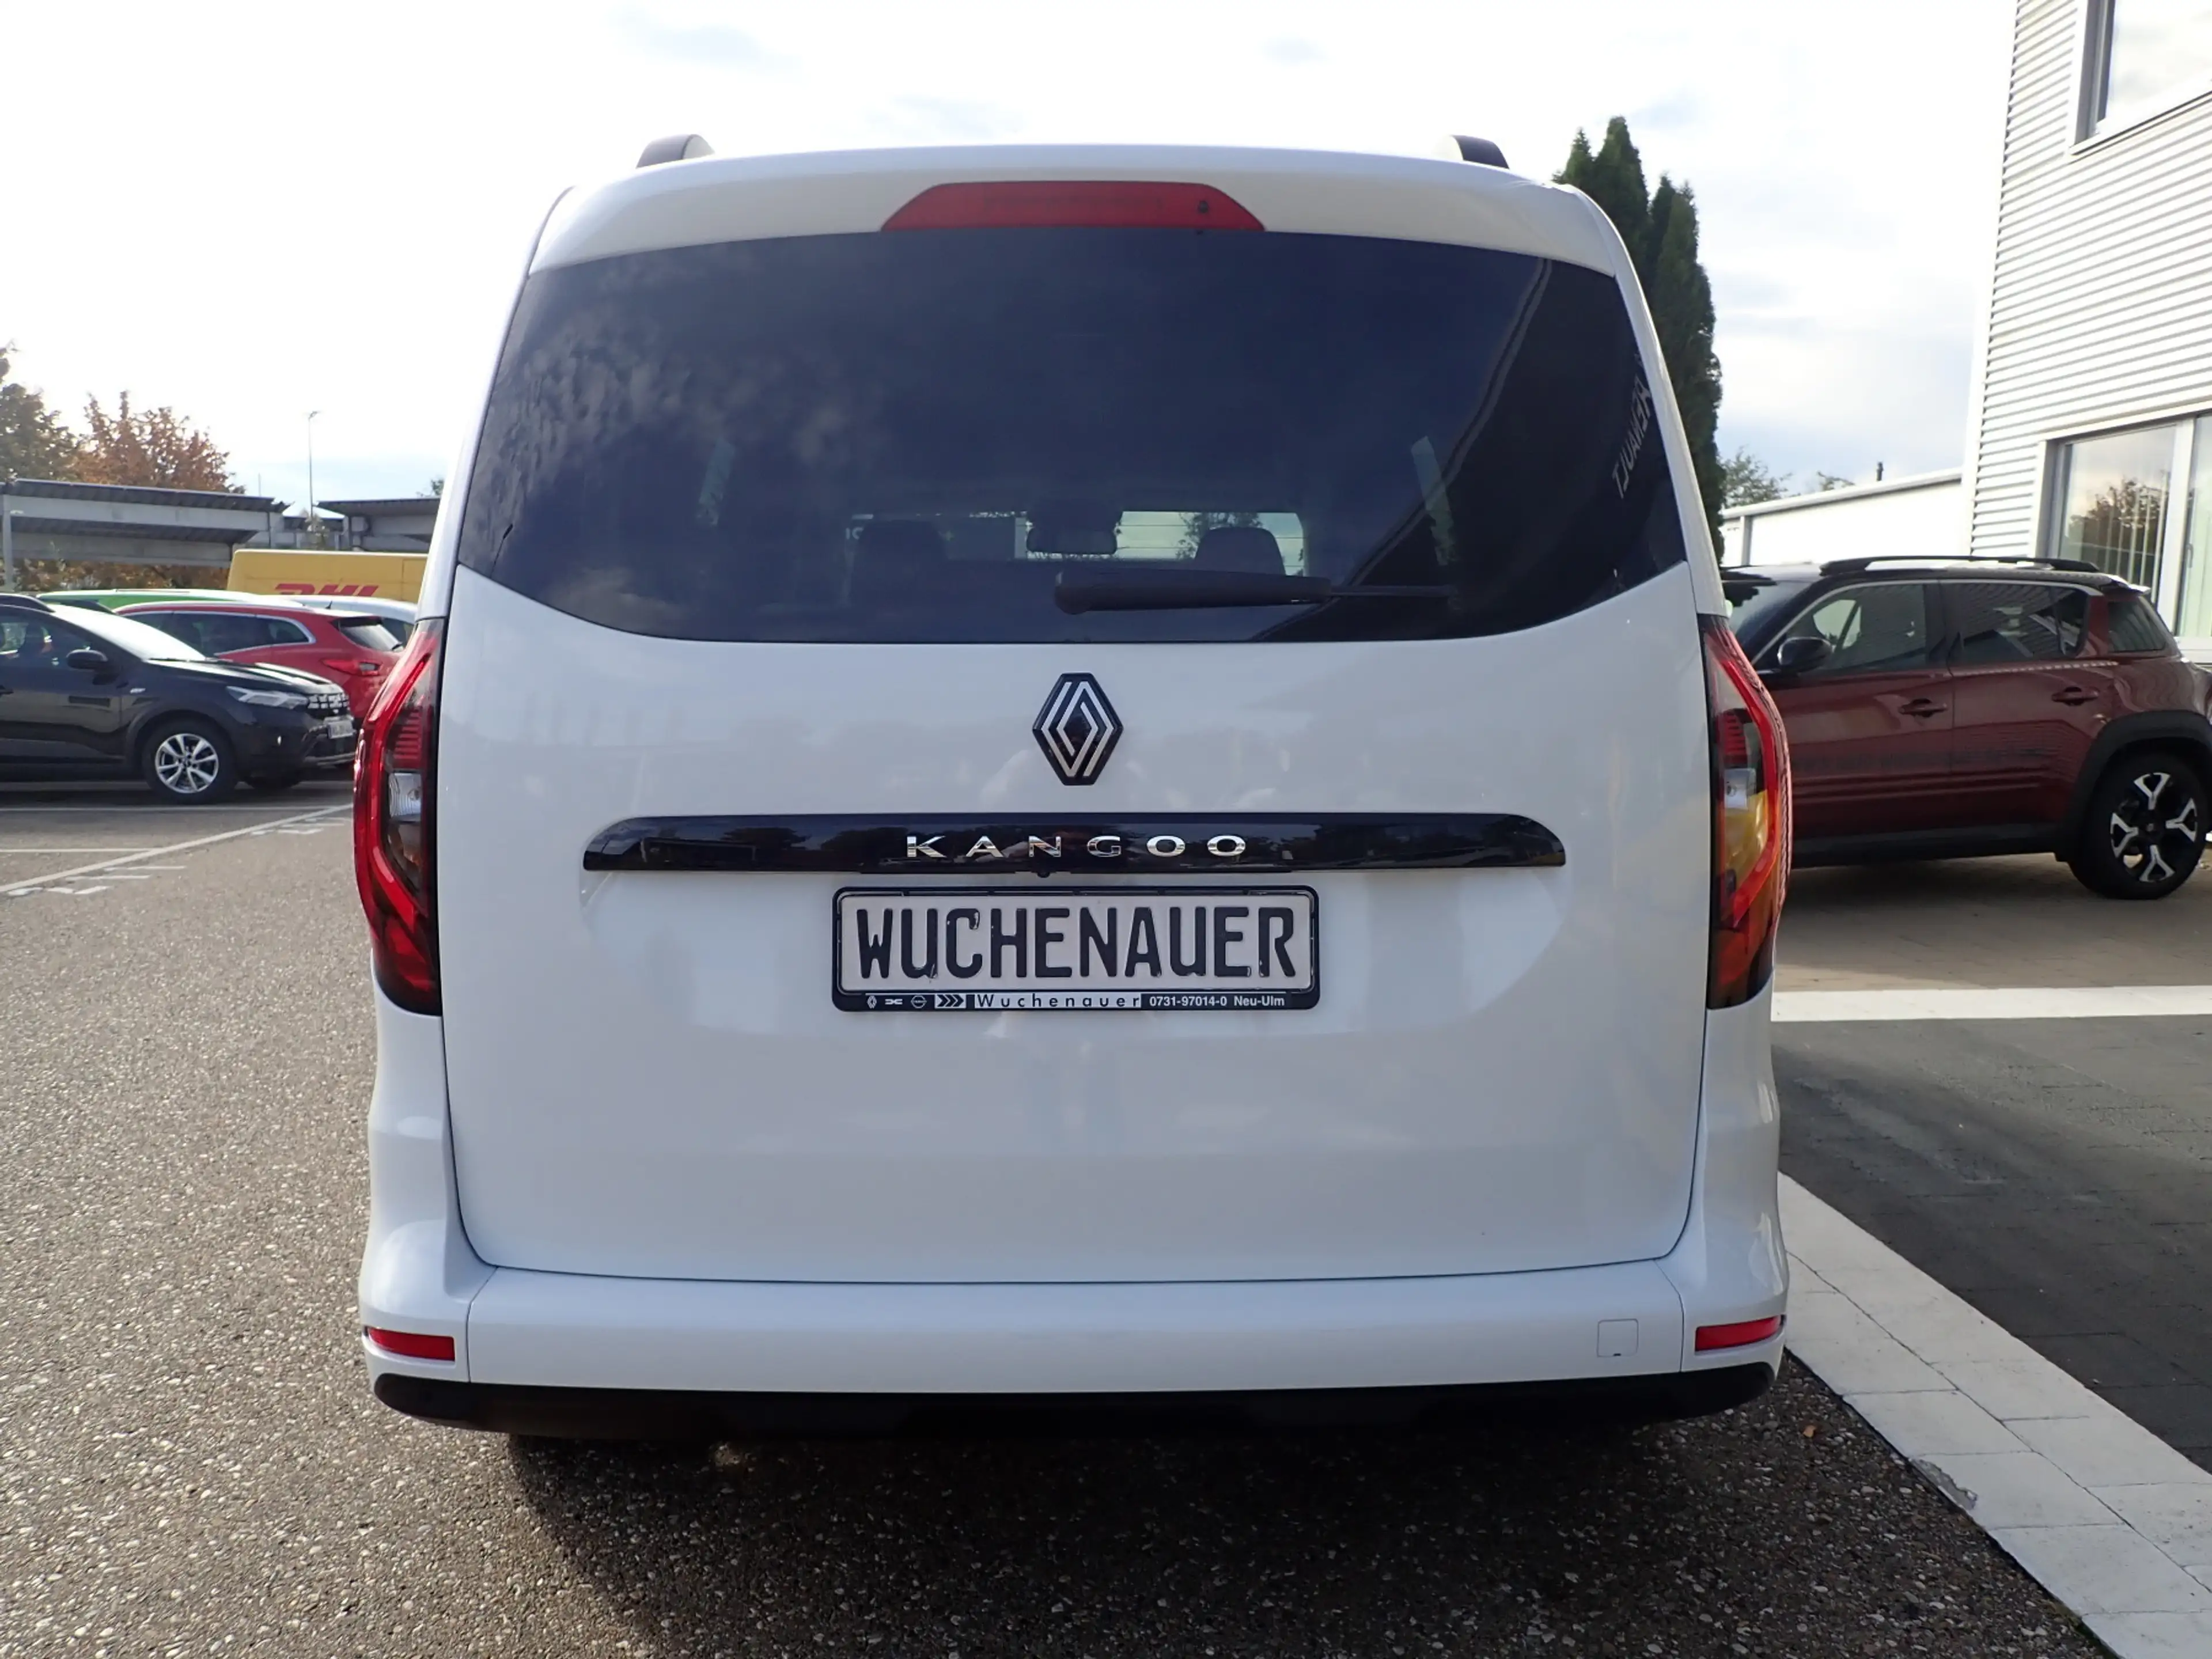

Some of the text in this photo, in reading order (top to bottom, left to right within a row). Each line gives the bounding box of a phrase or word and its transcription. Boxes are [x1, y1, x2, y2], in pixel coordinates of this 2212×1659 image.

[906, 835, 1247, 858] KANGOO
[856, 907, 1297, 979] WUCHENAUER
[977, 993, 1285, 1007] Wuchenauer 0731-97014-0 Neu-Ulm
